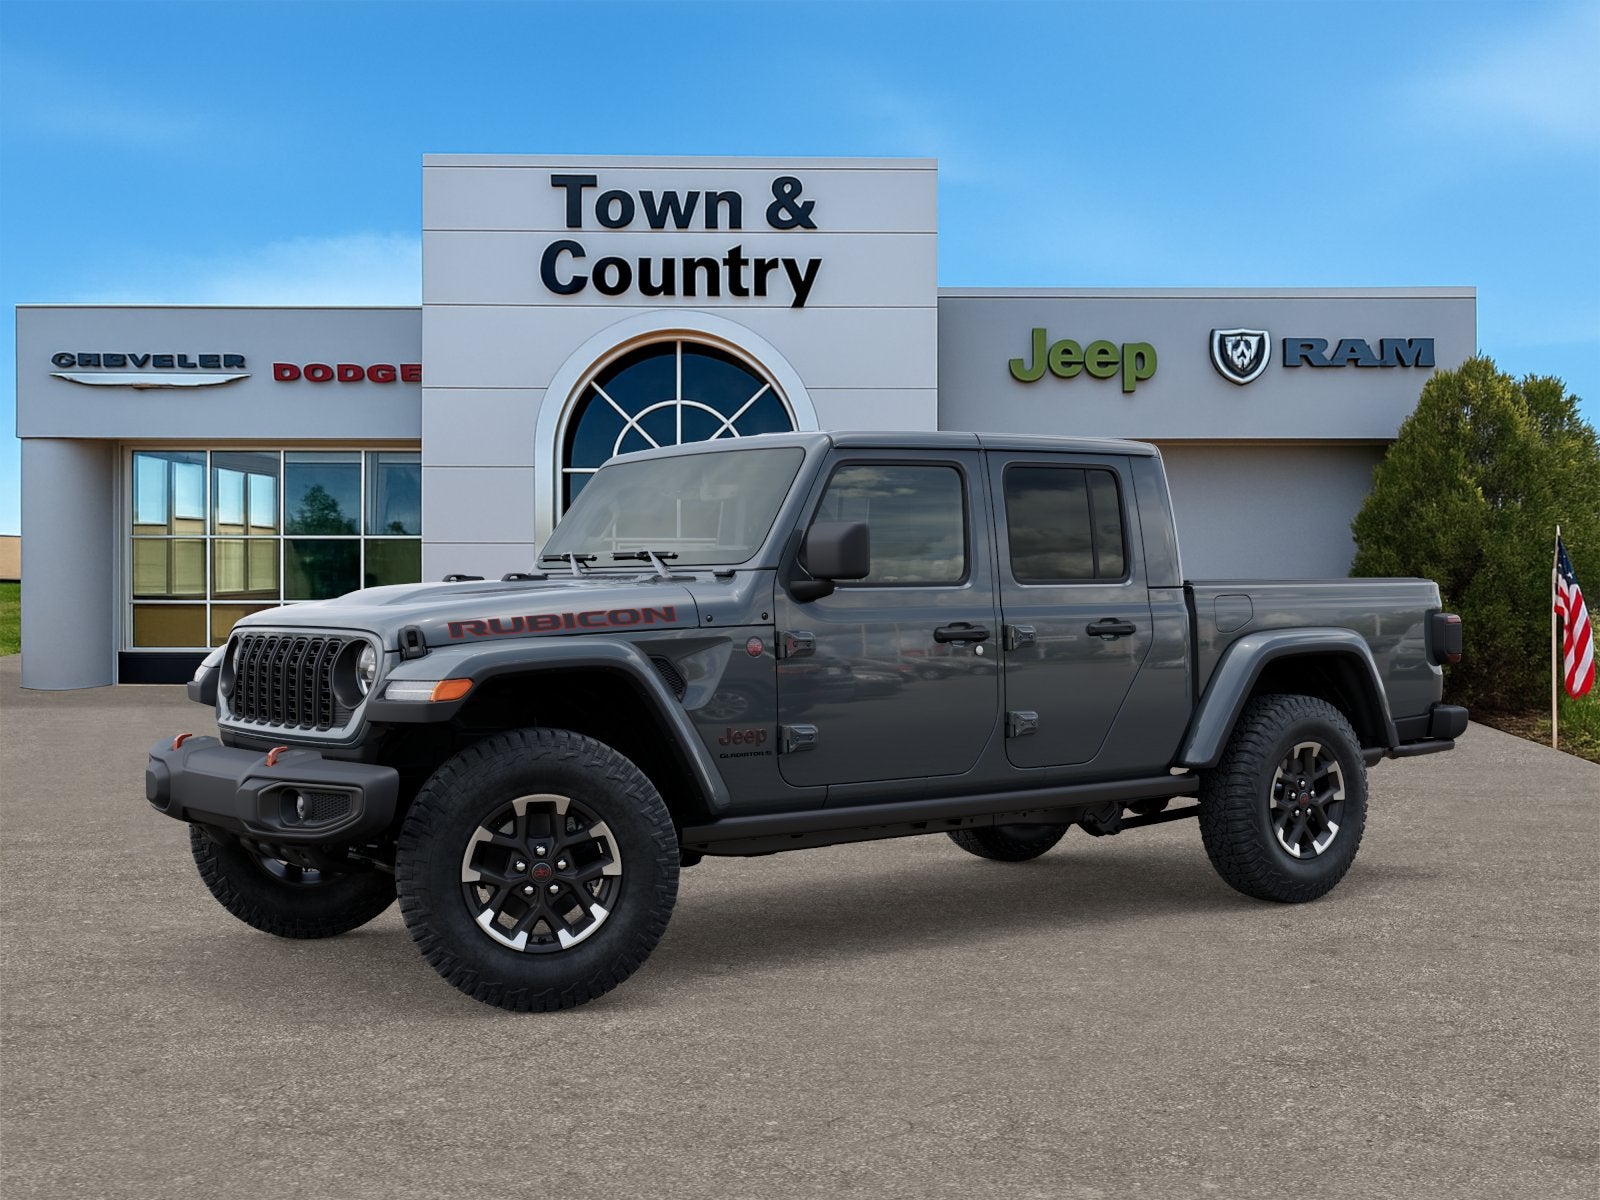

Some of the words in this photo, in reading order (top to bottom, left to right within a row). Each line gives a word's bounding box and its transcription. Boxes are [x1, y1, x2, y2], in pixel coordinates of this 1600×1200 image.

[550, 174, 742, 230] Town
[765, 175, 818, 230] &
[540, 239, 822, 308] Country
[1008, 327, 1158, 393] Jeep
[1283, 337, 1436, 368] RAM
[273, 362, 422, 383] DODGE
[447, 606, 677, 639] RUBICON
[719, 727, 767, 747] Jeep
